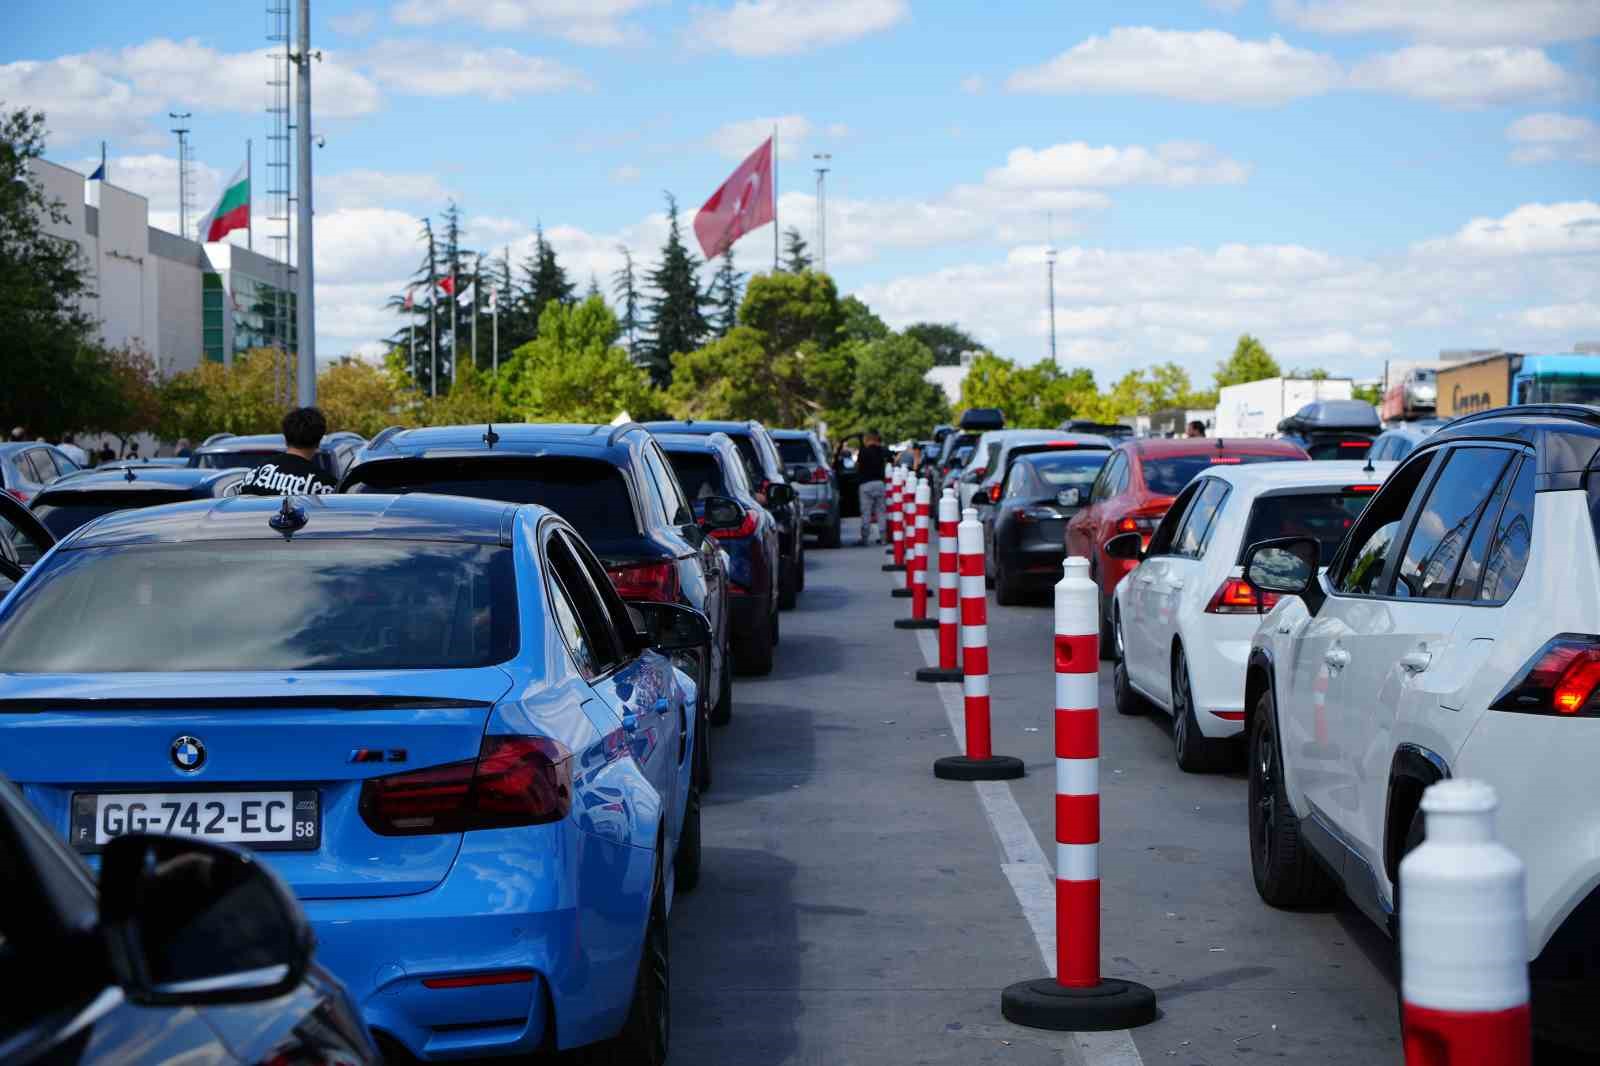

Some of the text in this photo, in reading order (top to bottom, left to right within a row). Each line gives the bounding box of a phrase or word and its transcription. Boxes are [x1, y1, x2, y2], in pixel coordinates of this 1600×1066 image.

[103, 801, 286, 836] GG-742-EC
[80, 827, 88, 840] F
[295, 821, 315, 837] 58
